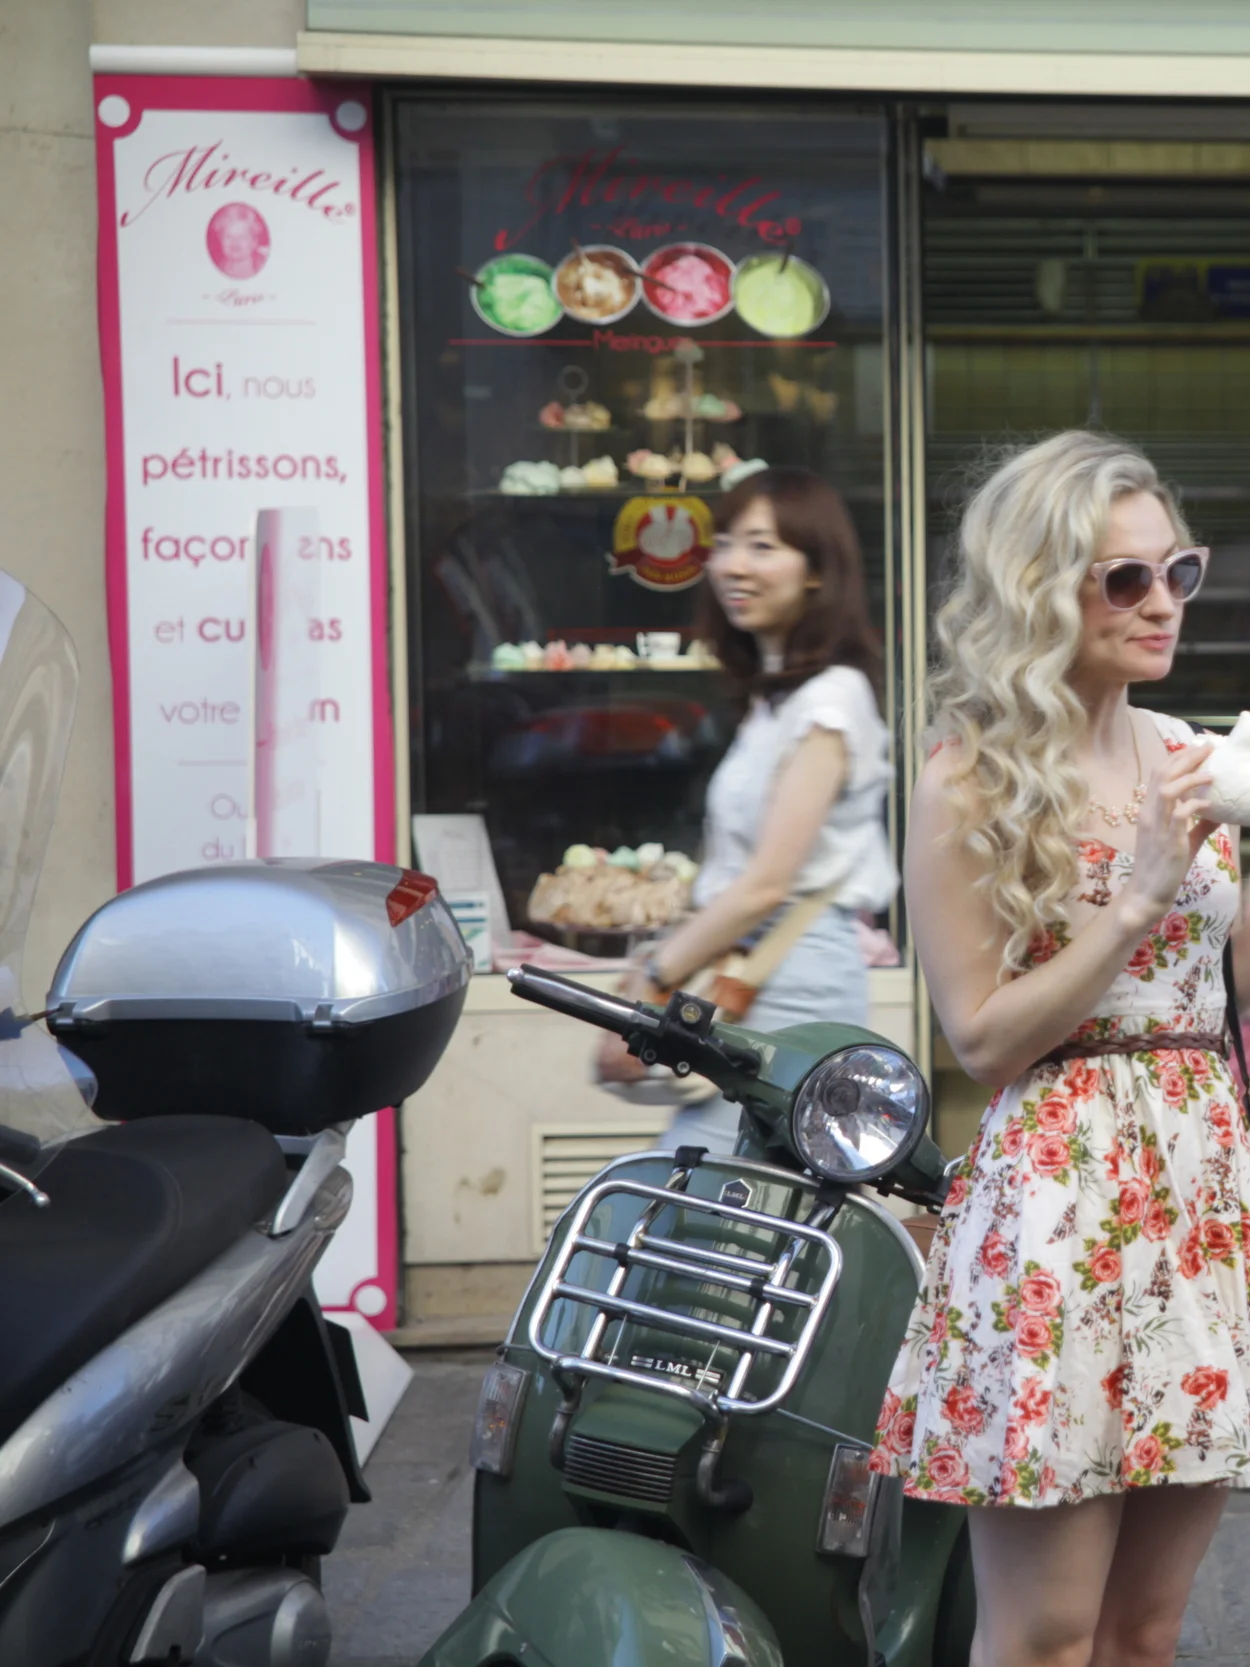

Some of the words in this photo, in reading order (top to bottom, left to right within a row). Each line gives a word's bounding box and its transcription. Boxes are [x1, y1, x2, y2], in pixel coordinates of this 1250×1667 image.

[119, 139, 346, 228] Mireille
[494, 145, 788, 251] Mireille
[172, 355, 232, 401] Ici,
[242, 373, 317, 400] nous
[141, 447, 349, 487] pétrissons,
[153, 616, 185, 644] et
[159, 696, 241, 725] votre
[654, 1359, 692, 1377] LML
